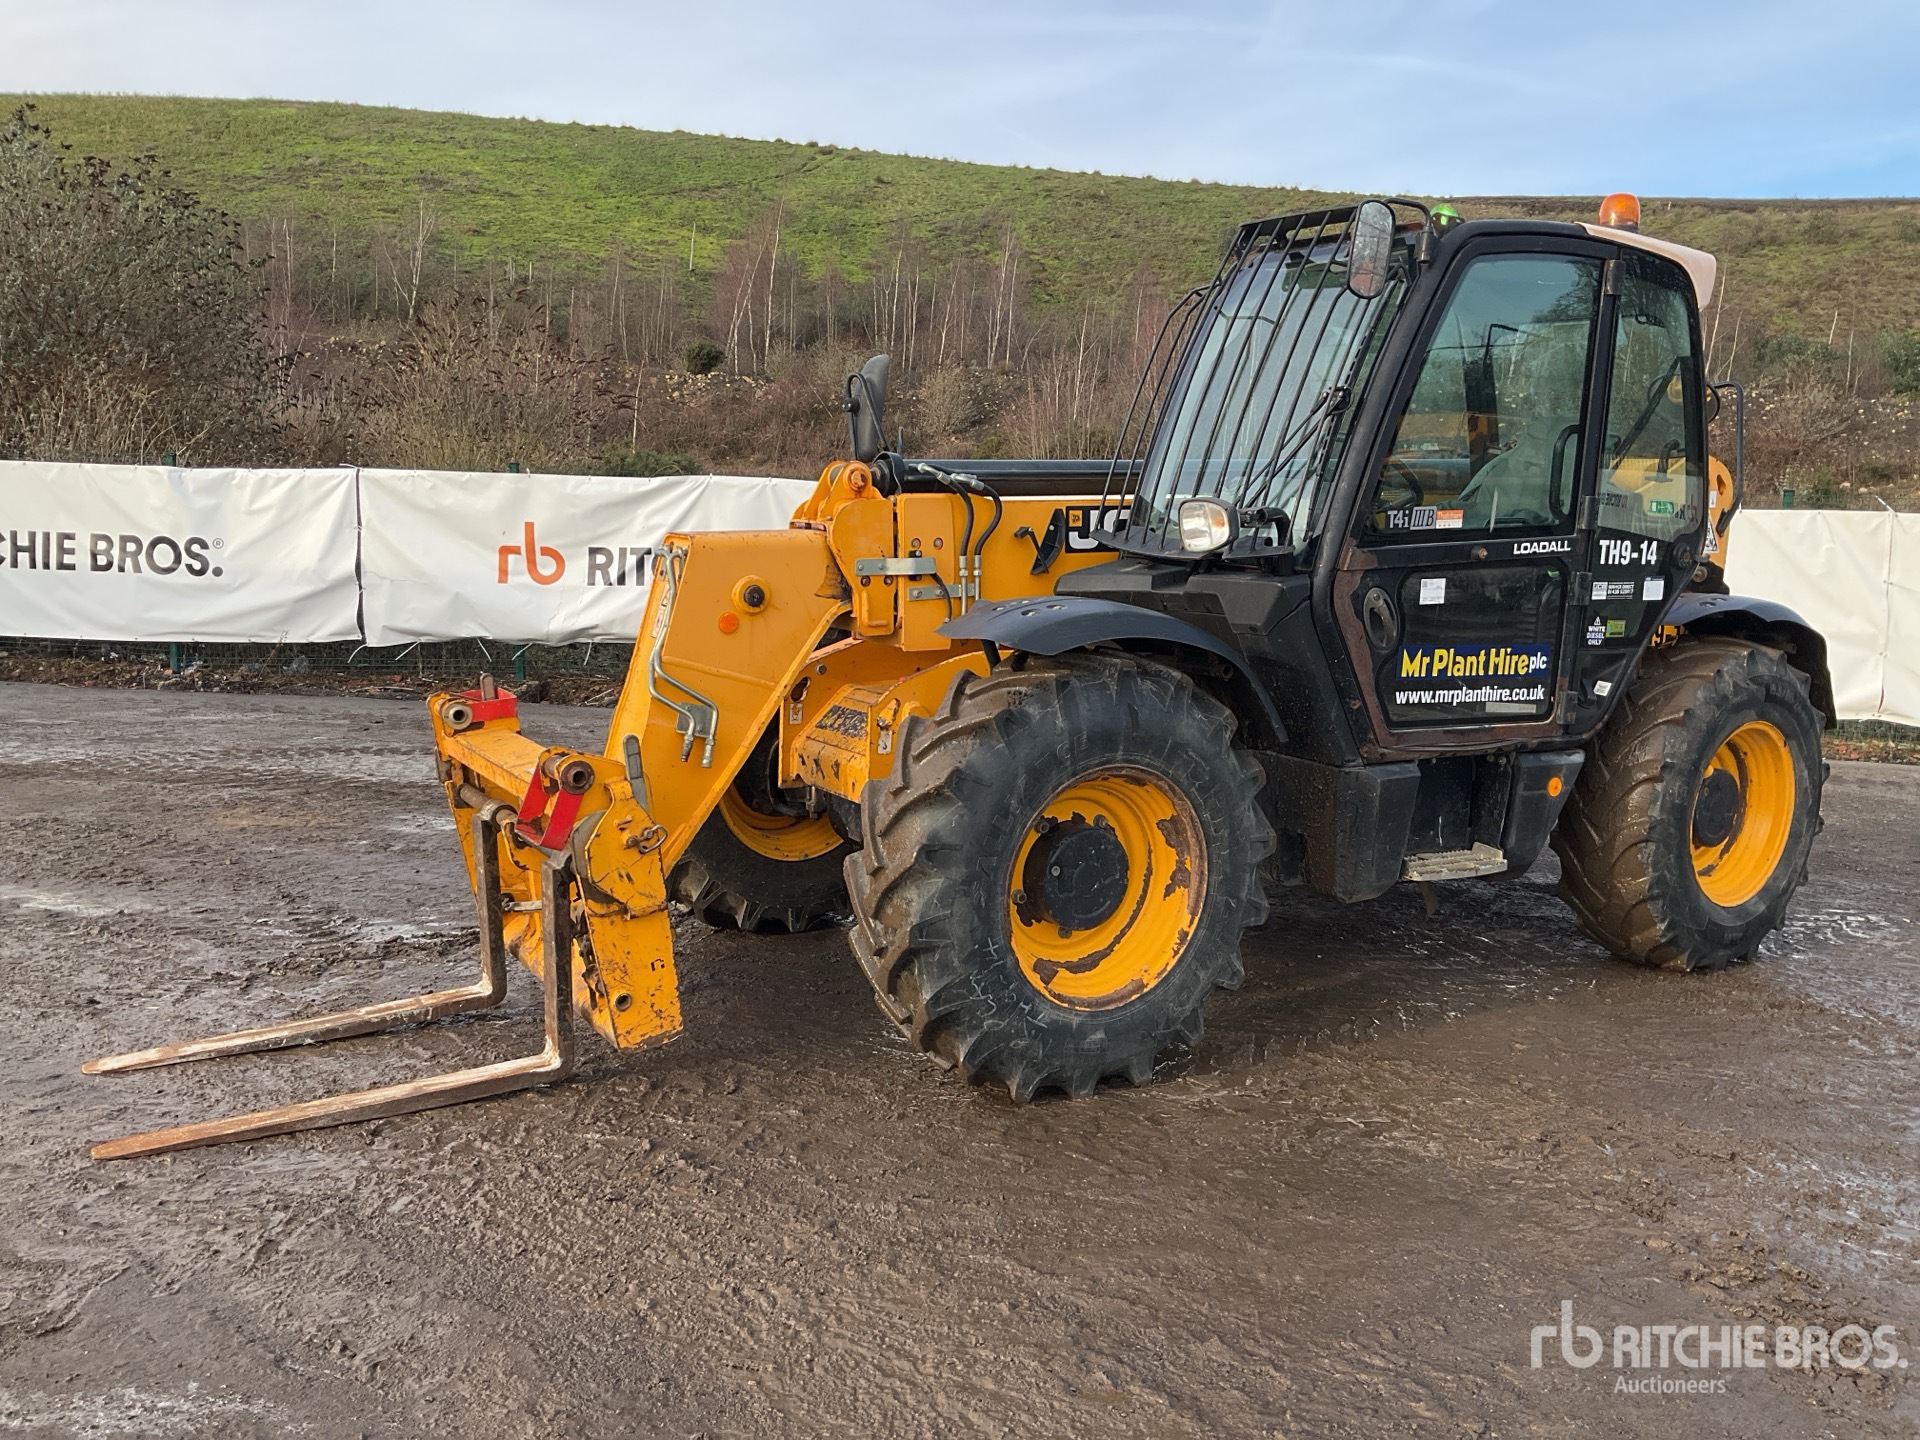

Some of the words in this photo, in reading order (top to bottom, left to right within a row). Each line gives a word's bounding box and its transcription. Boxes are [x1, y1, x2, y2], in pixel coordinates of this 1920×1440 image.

[1387, 510, 1410, 528] T4i
[0, 530, 77, 571] HIE
[497, 521, 566, 586] rb
[586, 546, 658, 586] RIT
[1513, 540, 1571, 555] LOADALL
[1599, 539, 1658, 565] TH9-14
[1400, 648, 1430, 678] Mr
[1431, 648, 1486, 677] Plant
[1488, 648, 1529, 676] Hire
[1529, 652, 1547, 673] plc
[1395, 684, 1545, 706] www.mrplanthire.co.uk
